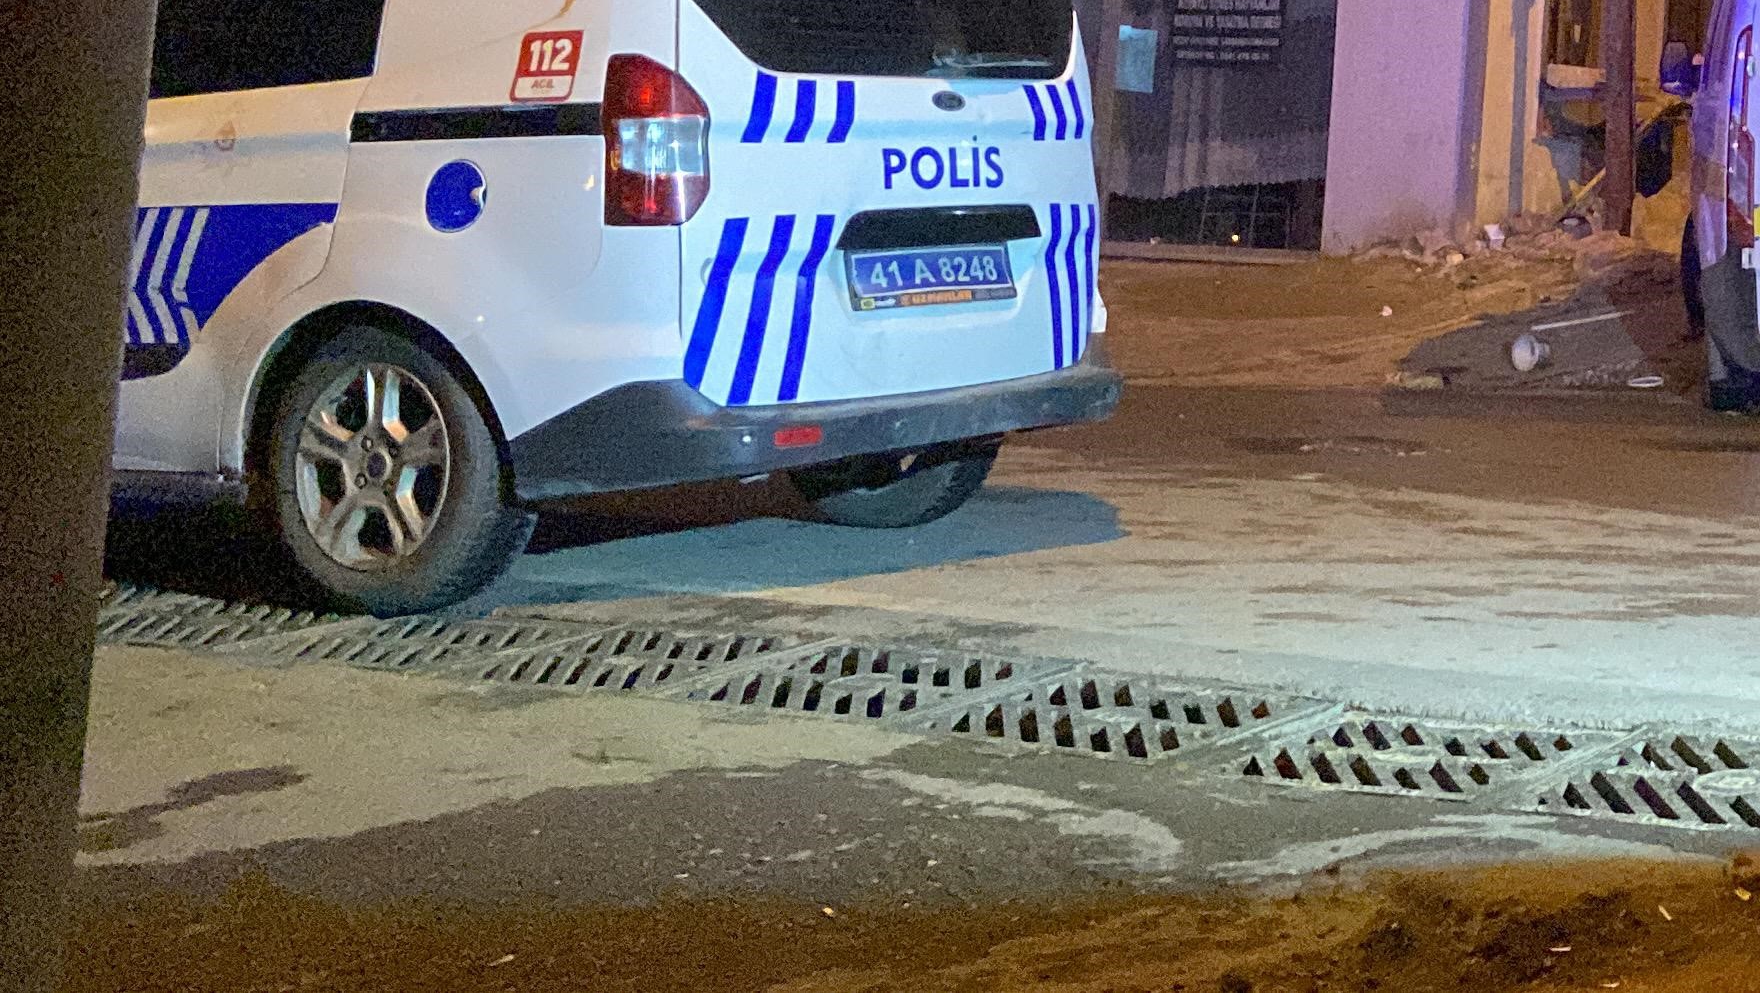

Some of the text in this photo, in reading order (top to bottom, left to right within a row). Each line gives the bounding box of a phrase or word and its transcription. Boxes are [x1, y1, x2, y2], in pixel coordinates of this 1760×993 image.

[529, 38, 573, 72] 112
[881, 135, 1004, 190] POLİS
[871, 255, 998, 288] 41 A 8248
